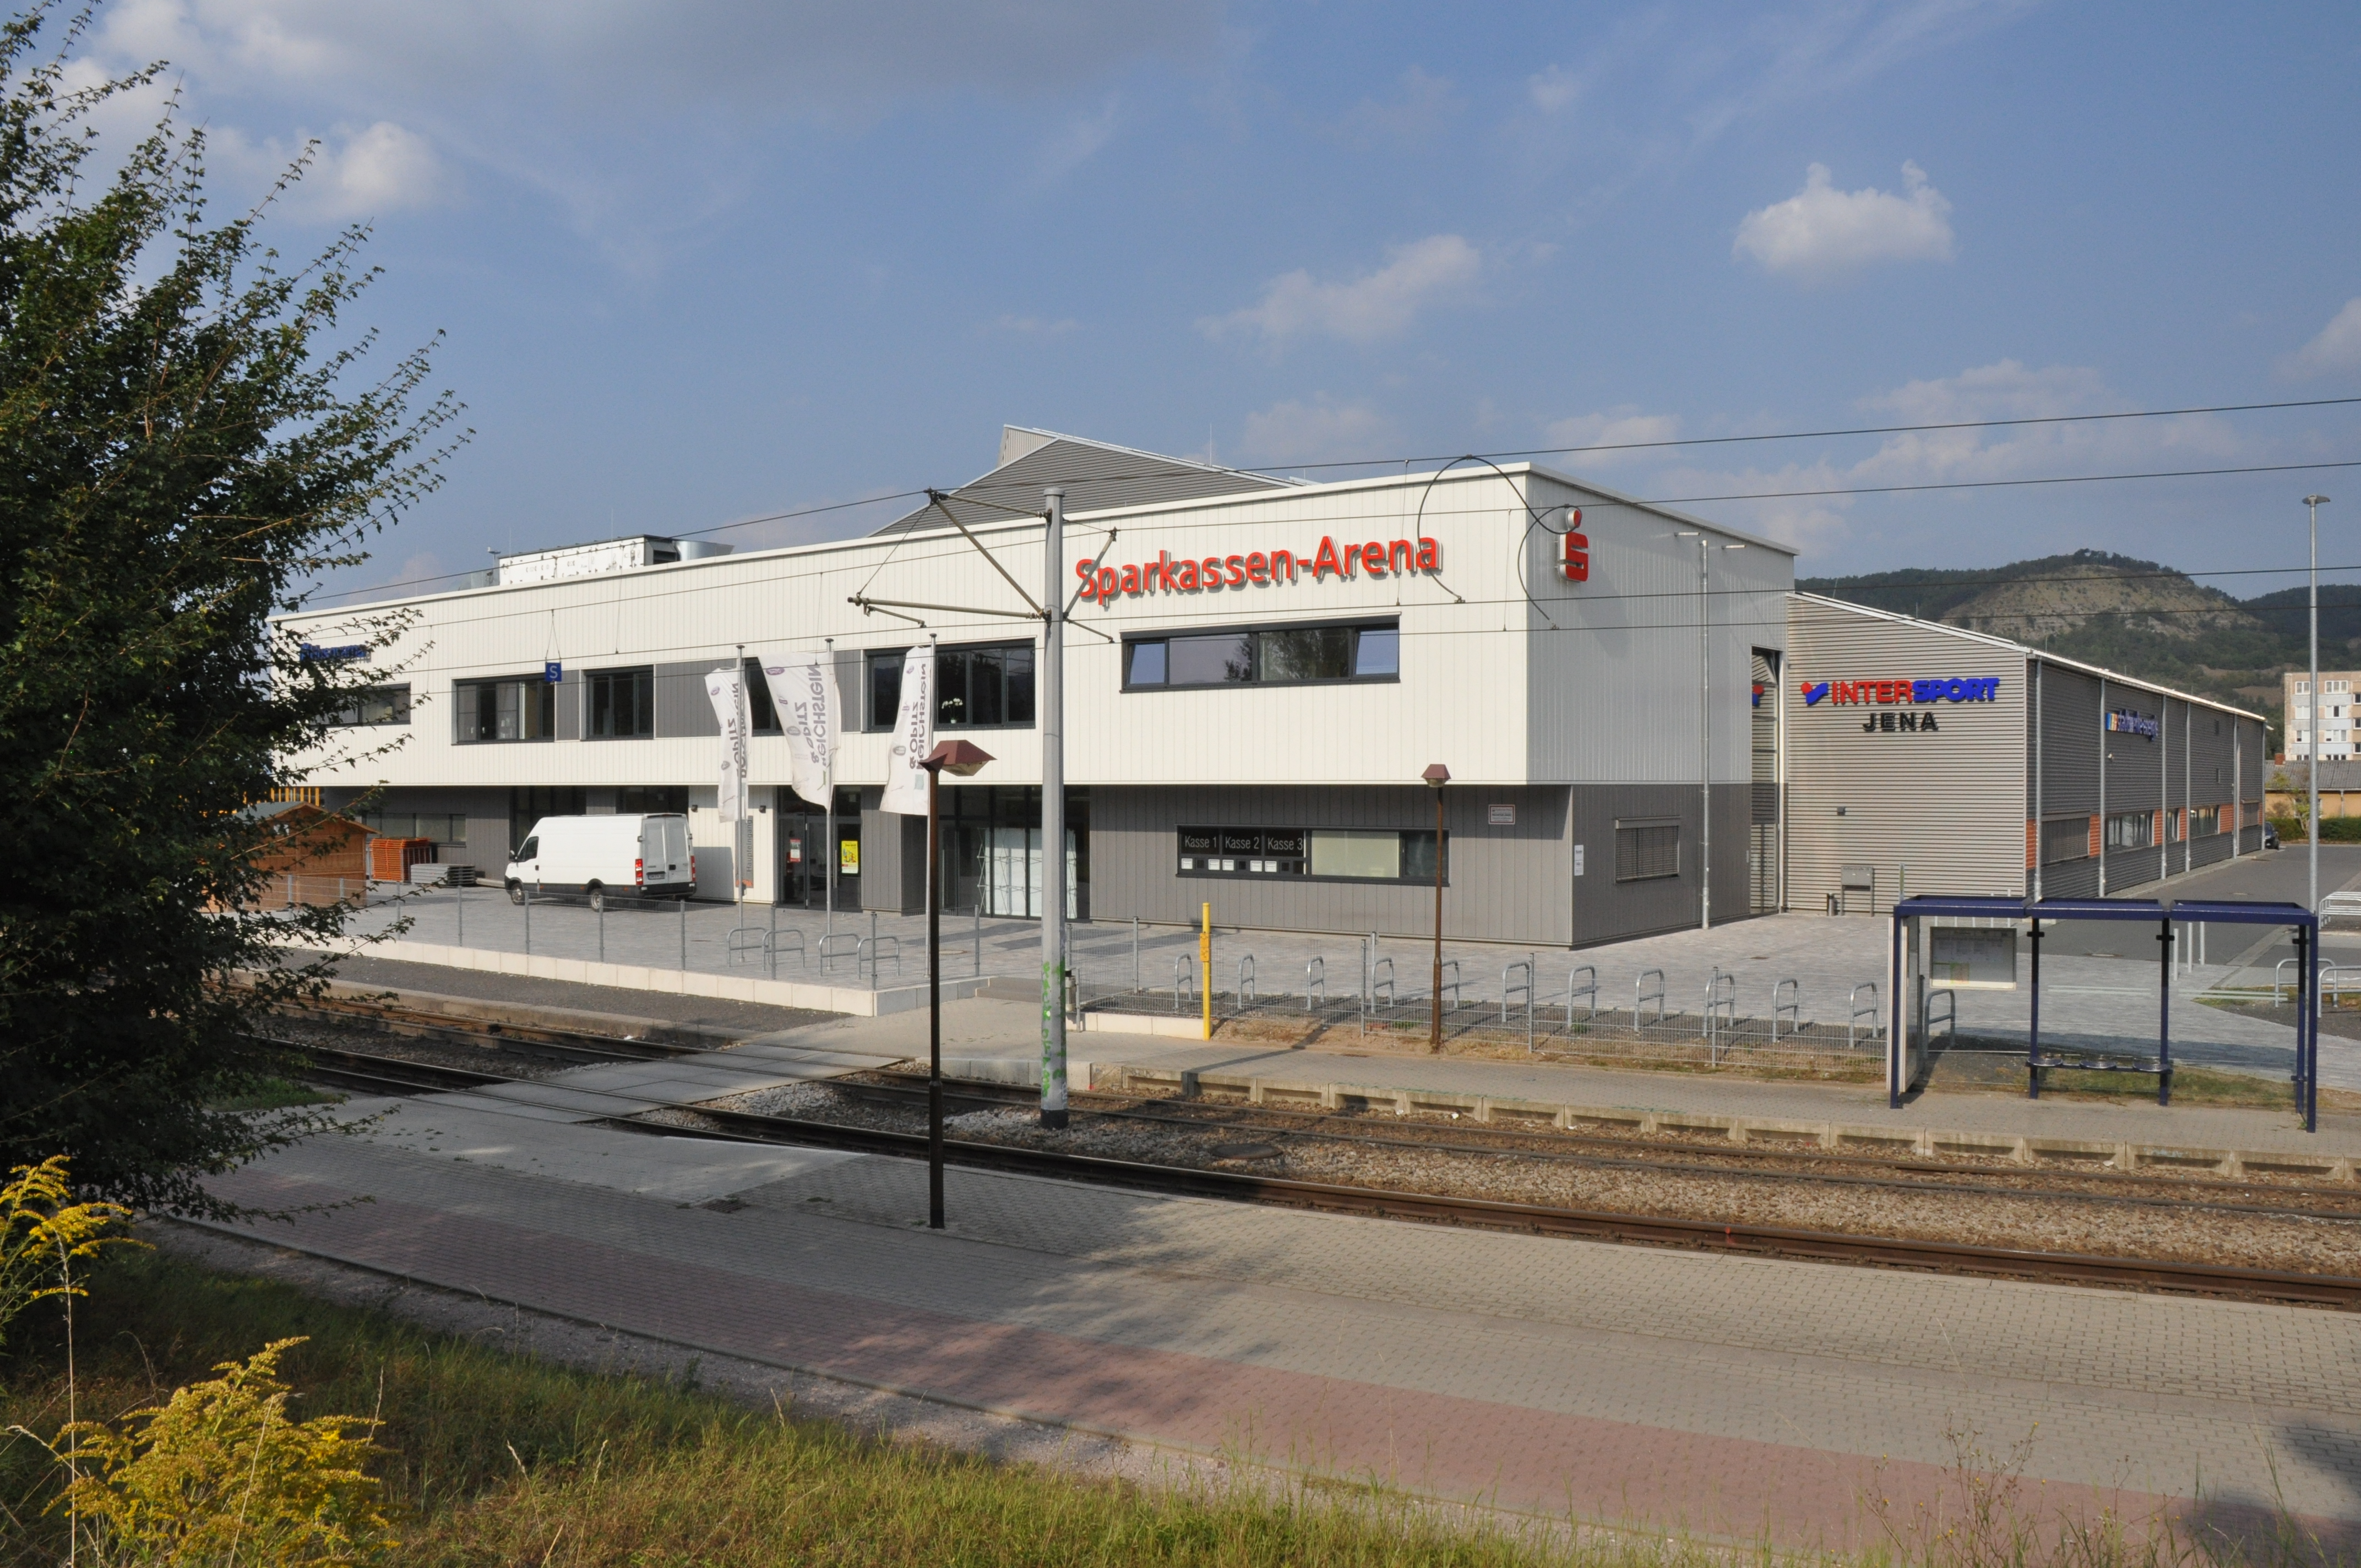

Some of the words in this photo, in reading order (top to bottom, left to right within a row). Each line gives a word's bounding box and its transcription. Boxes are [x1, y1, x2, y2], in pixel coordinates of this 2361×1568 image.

[1075, 536, 1438, 606] Sparkassen-Arena
[550, 665, 558, 678] S
[1832, 678, 2000, 704] INTERSPORT
[1862, 712, 1938, 731] JENA
[1185, 835, 1210, 848] Kasse
[1213, 836, 1217, 848] 1
[1225, 836, 1250, 849] Kasse
[1254, 837, 1260, 850] 2
[1267, 837, 1294, 850] Kasse
[1297, 838, 1303, 851] 3
